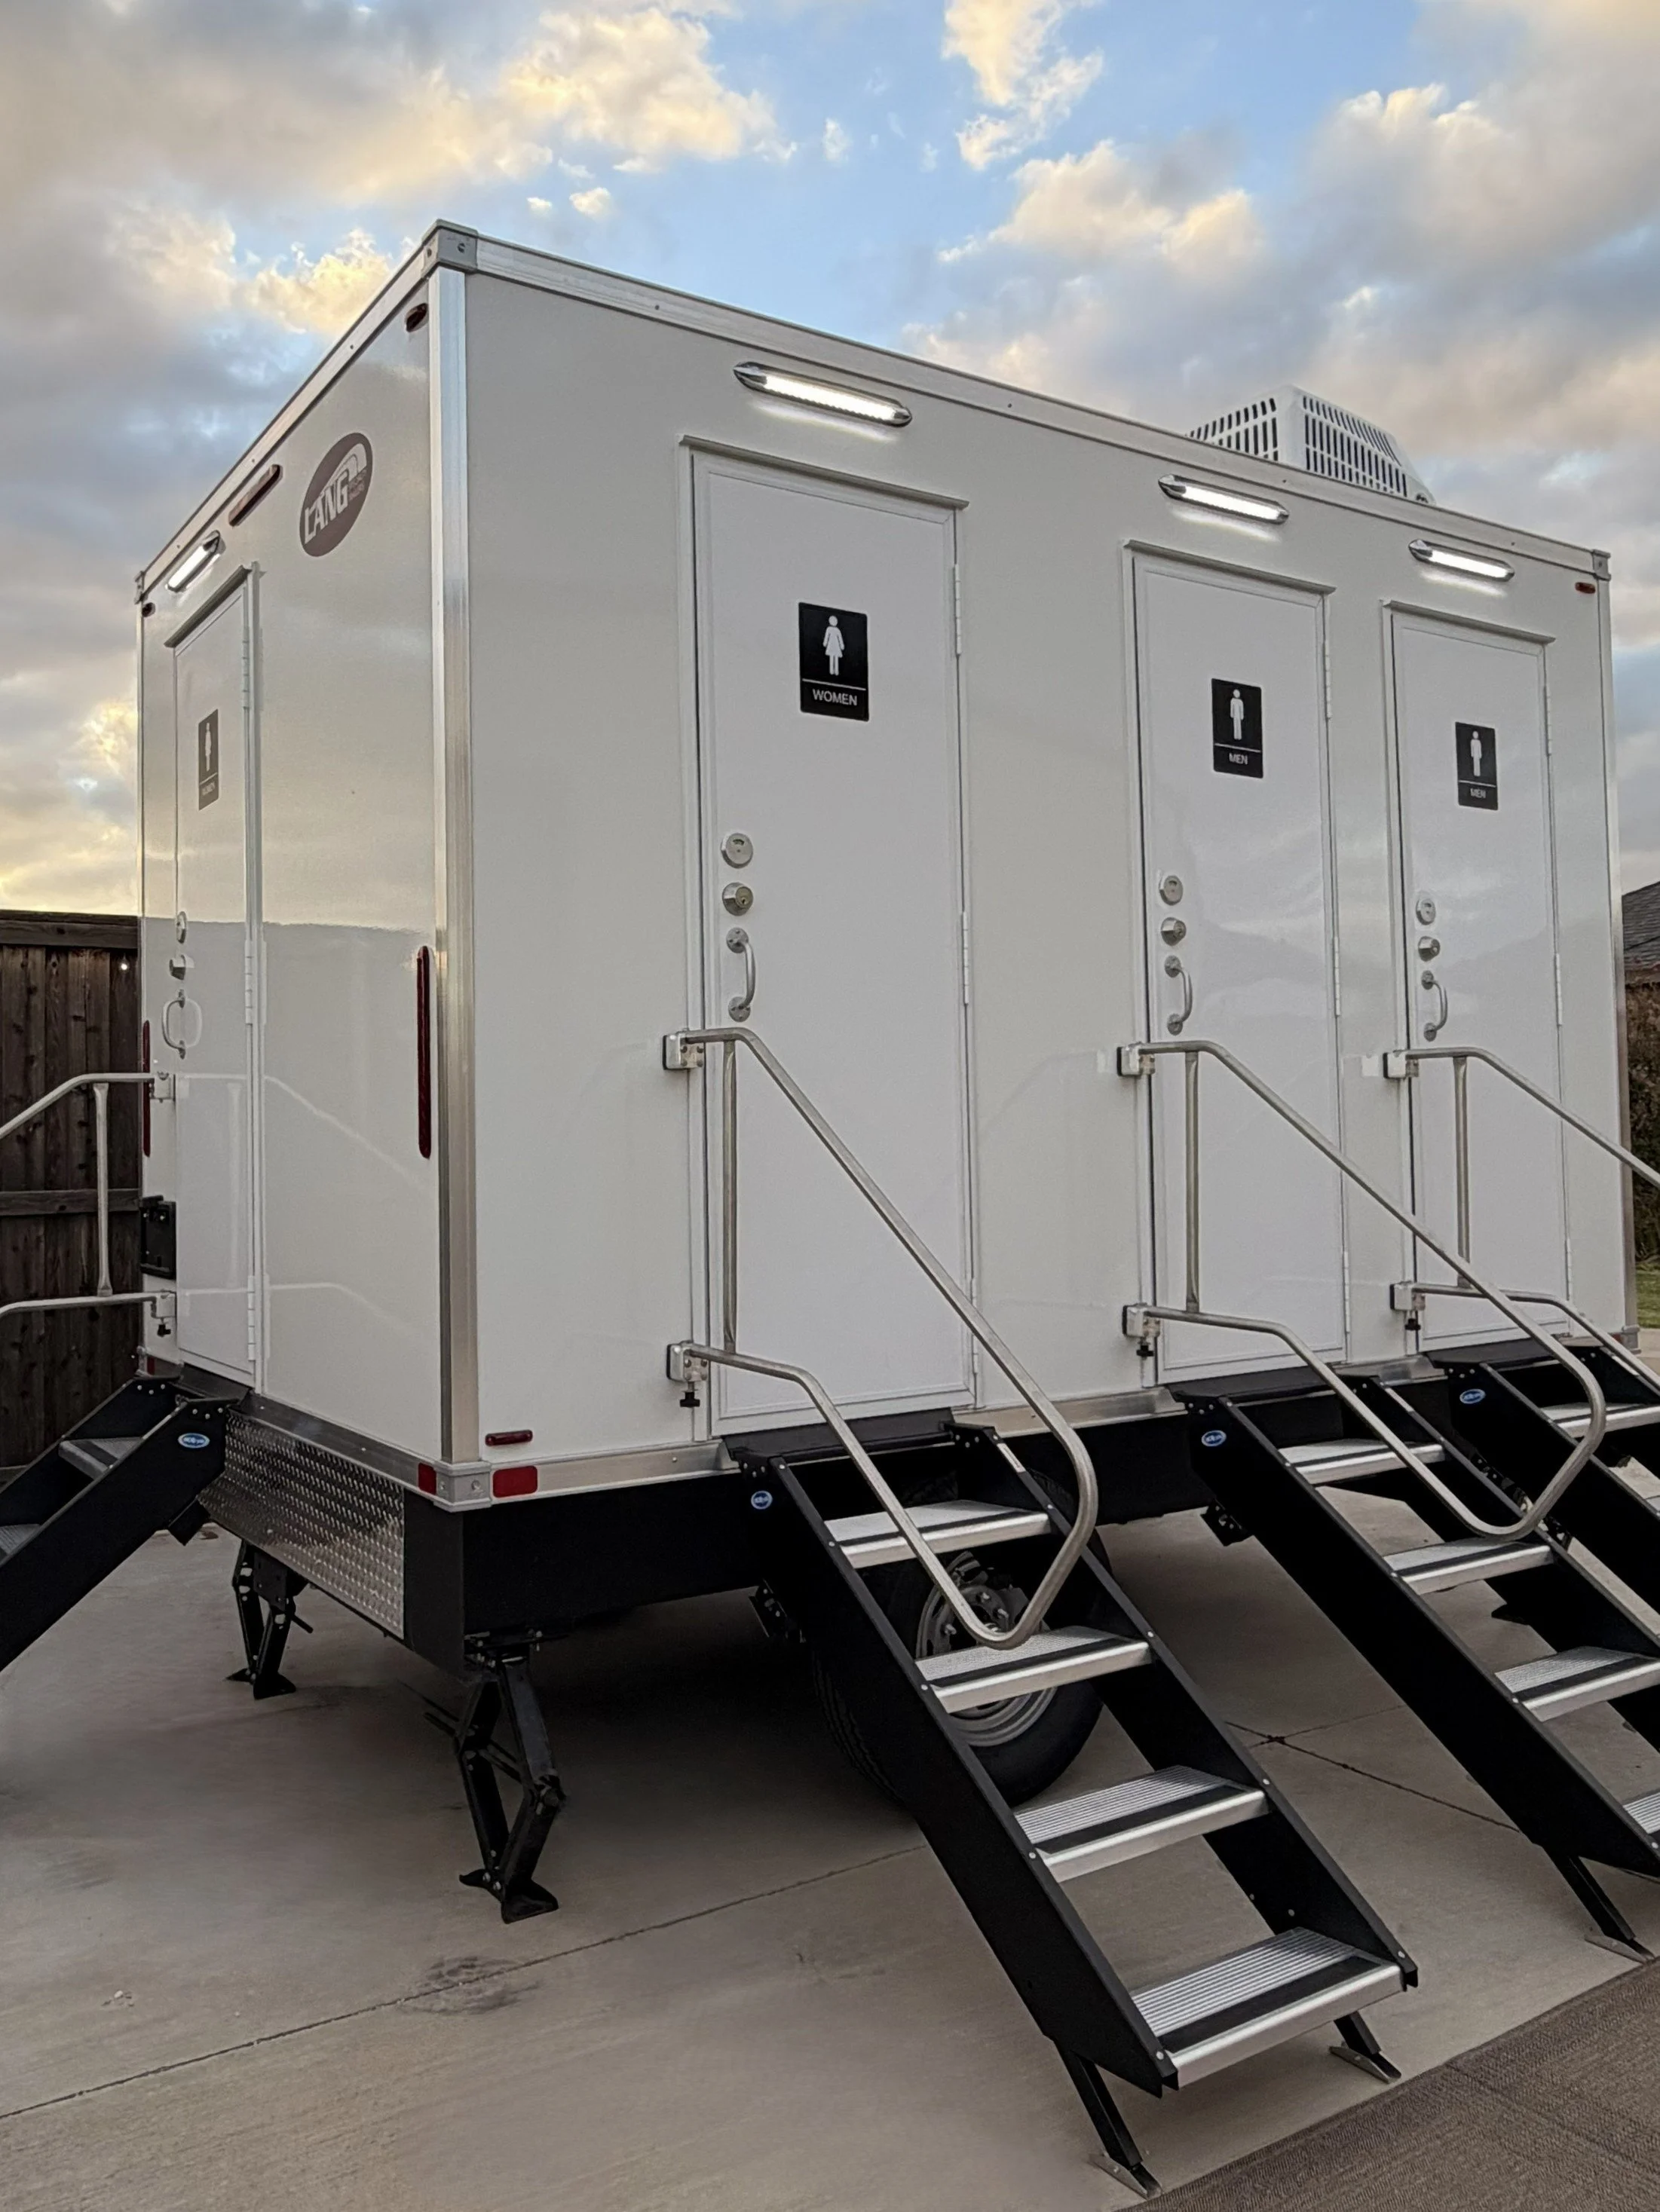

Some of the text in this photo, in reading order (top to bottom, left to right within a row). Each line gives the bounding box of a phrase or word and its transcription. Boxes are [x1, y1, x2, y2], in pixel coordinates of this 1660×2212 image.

[304, 470, 349, 545] LANG
[812, 688, 858, 706] WOMEN
[1229, 752, 1248, 765] MEN
[1470, 787, 1487, 799] MEN
